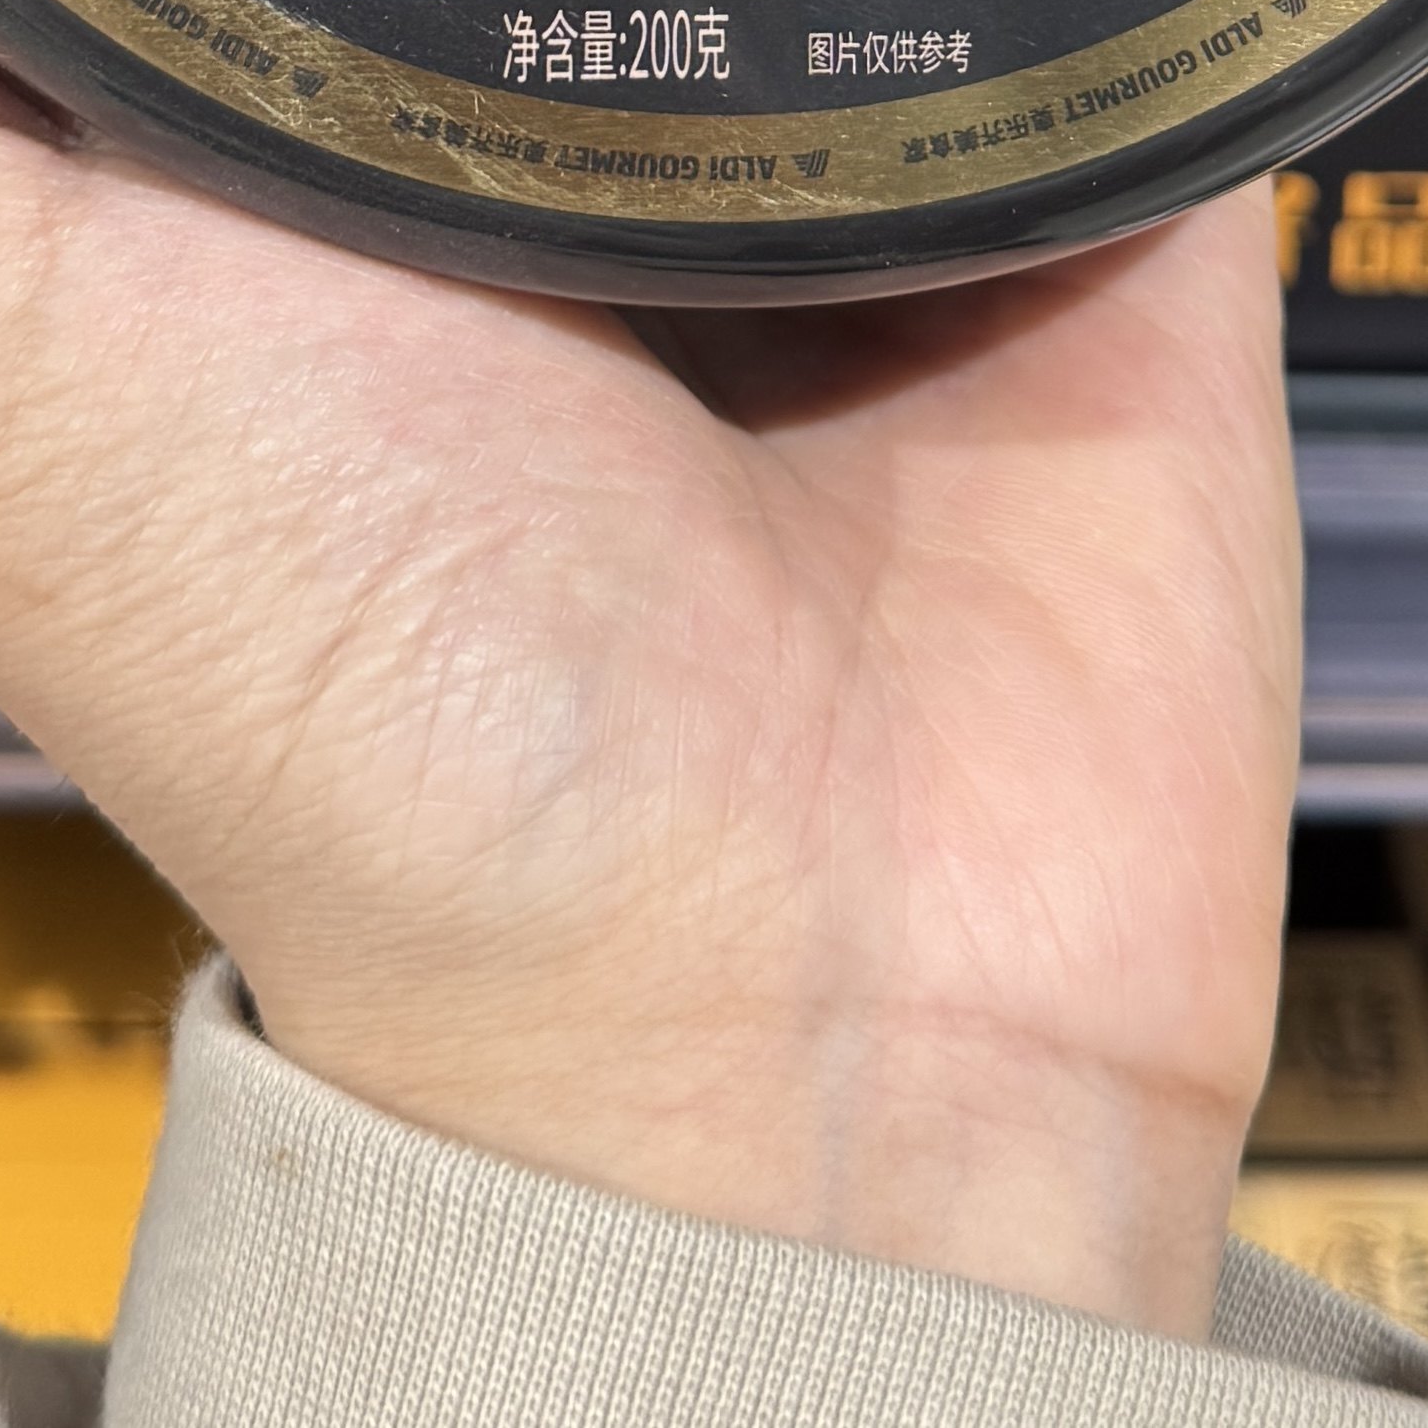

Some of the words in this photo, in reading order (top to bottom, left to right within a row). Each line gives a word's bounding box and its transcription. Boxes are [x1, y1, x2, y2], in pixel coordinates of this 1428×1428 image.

[209, 29, 278, 77] ALDI
[502, 6, 731, 83] 净含量:200克
[807, 30, 972, 76] 图片仅供参考
[1202, 10, 1263, 64] ALDI
[1062, 50, 1199, 122] GOURMET
[556, 144, 700, 180] GOURMET
[708, 154, 777, 181] ALDI
